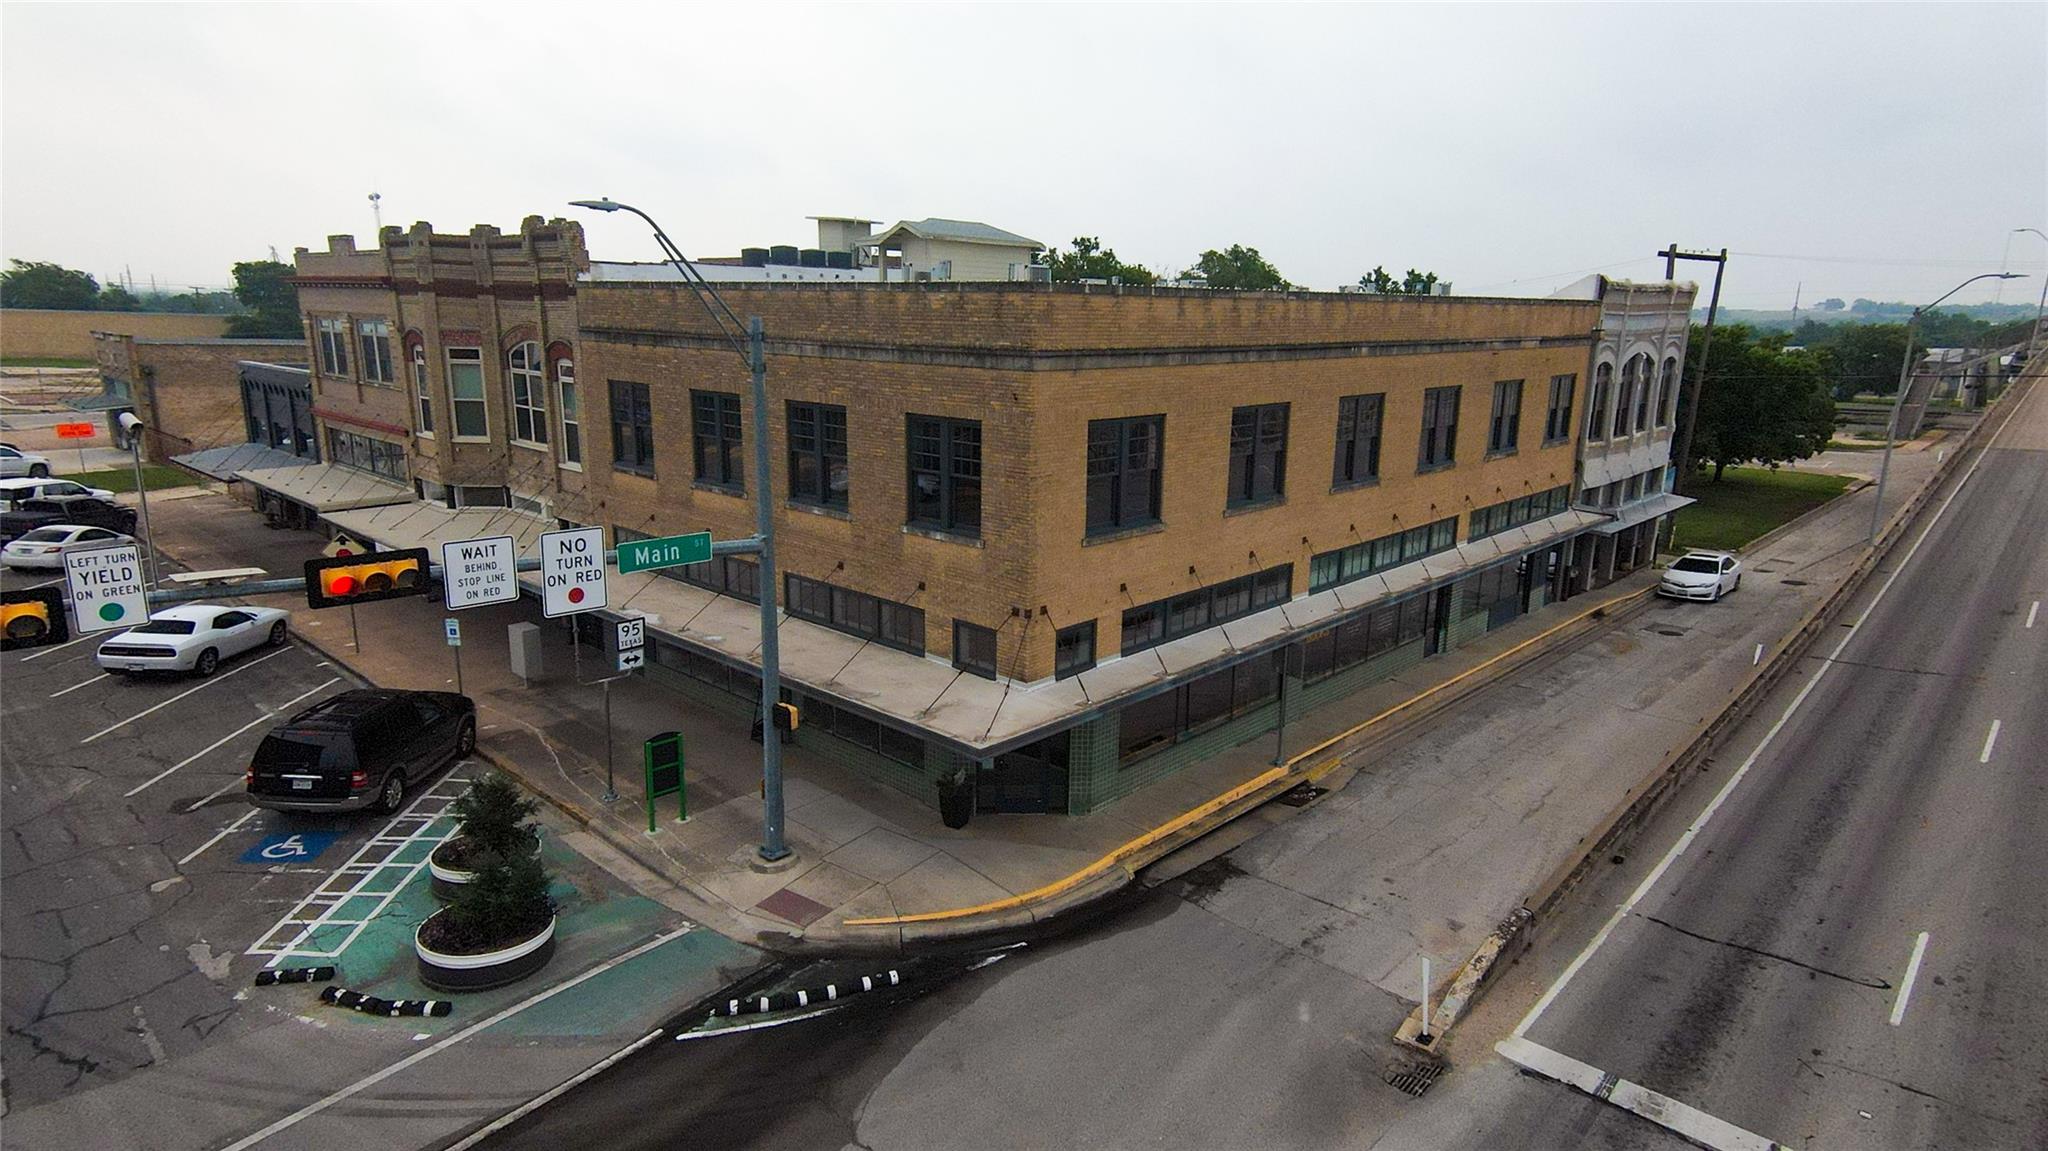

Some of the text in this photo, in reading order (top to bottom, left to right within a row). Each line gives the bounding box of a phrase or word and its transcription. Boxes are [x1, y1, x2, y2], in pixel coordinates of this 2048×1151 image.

[461, 544, 497, 560] WAIT
[559, 538, 587, 555] NO
[635, 538, 704, 565] Main ST
[70, 552, 136, 568] LEFT TURN
[464, 561, 497, 574] BEHIND
[556, 555, 593, 570] TURN
[78, 567, 132, 586] YIELD
[458, 573, 506, 588] STOP LINE
[547, 569, 602, 587] ON RED
[76, 584, 141, 601] ON GREEN
[466, 587, 500, 600] ON RED
[621, 623, 640, 637] 95
[620, 637, 642, 647] TEXAS
